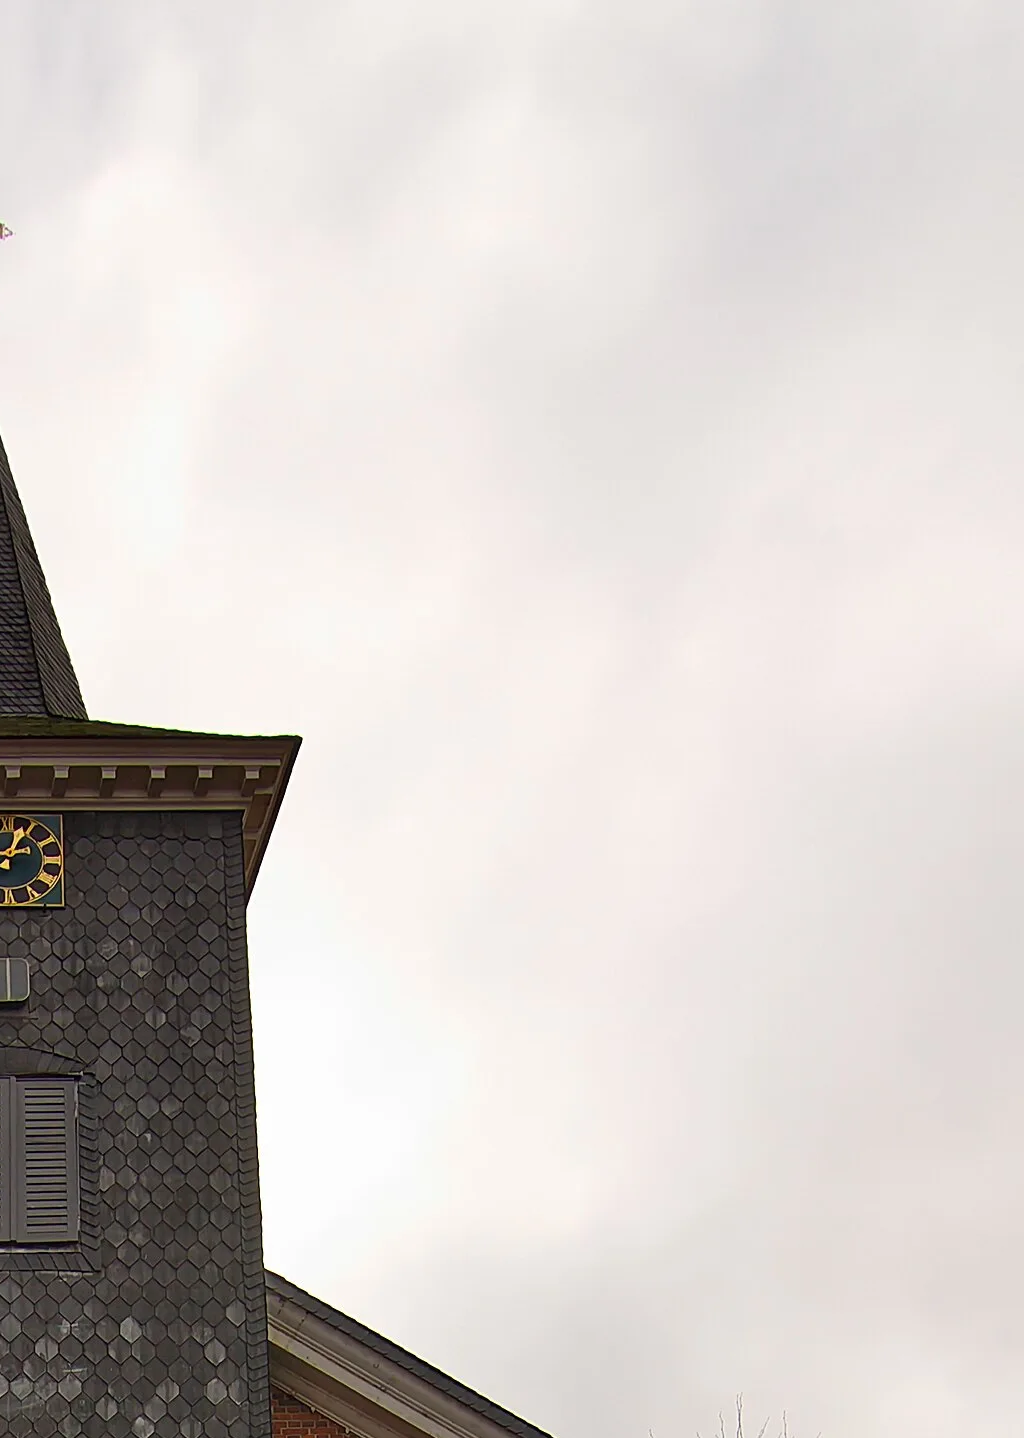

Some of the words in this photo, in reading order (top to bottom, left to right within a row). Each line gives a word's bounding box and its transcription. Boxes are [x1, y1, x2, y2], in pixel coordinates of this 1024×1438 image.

[0, 817, 15, 831] XII
[37, 835, 56, 848] II
[43, 855, 61, 866] III
[3, 888, 18, 904] VI
[26, 885, 42, 901] V
